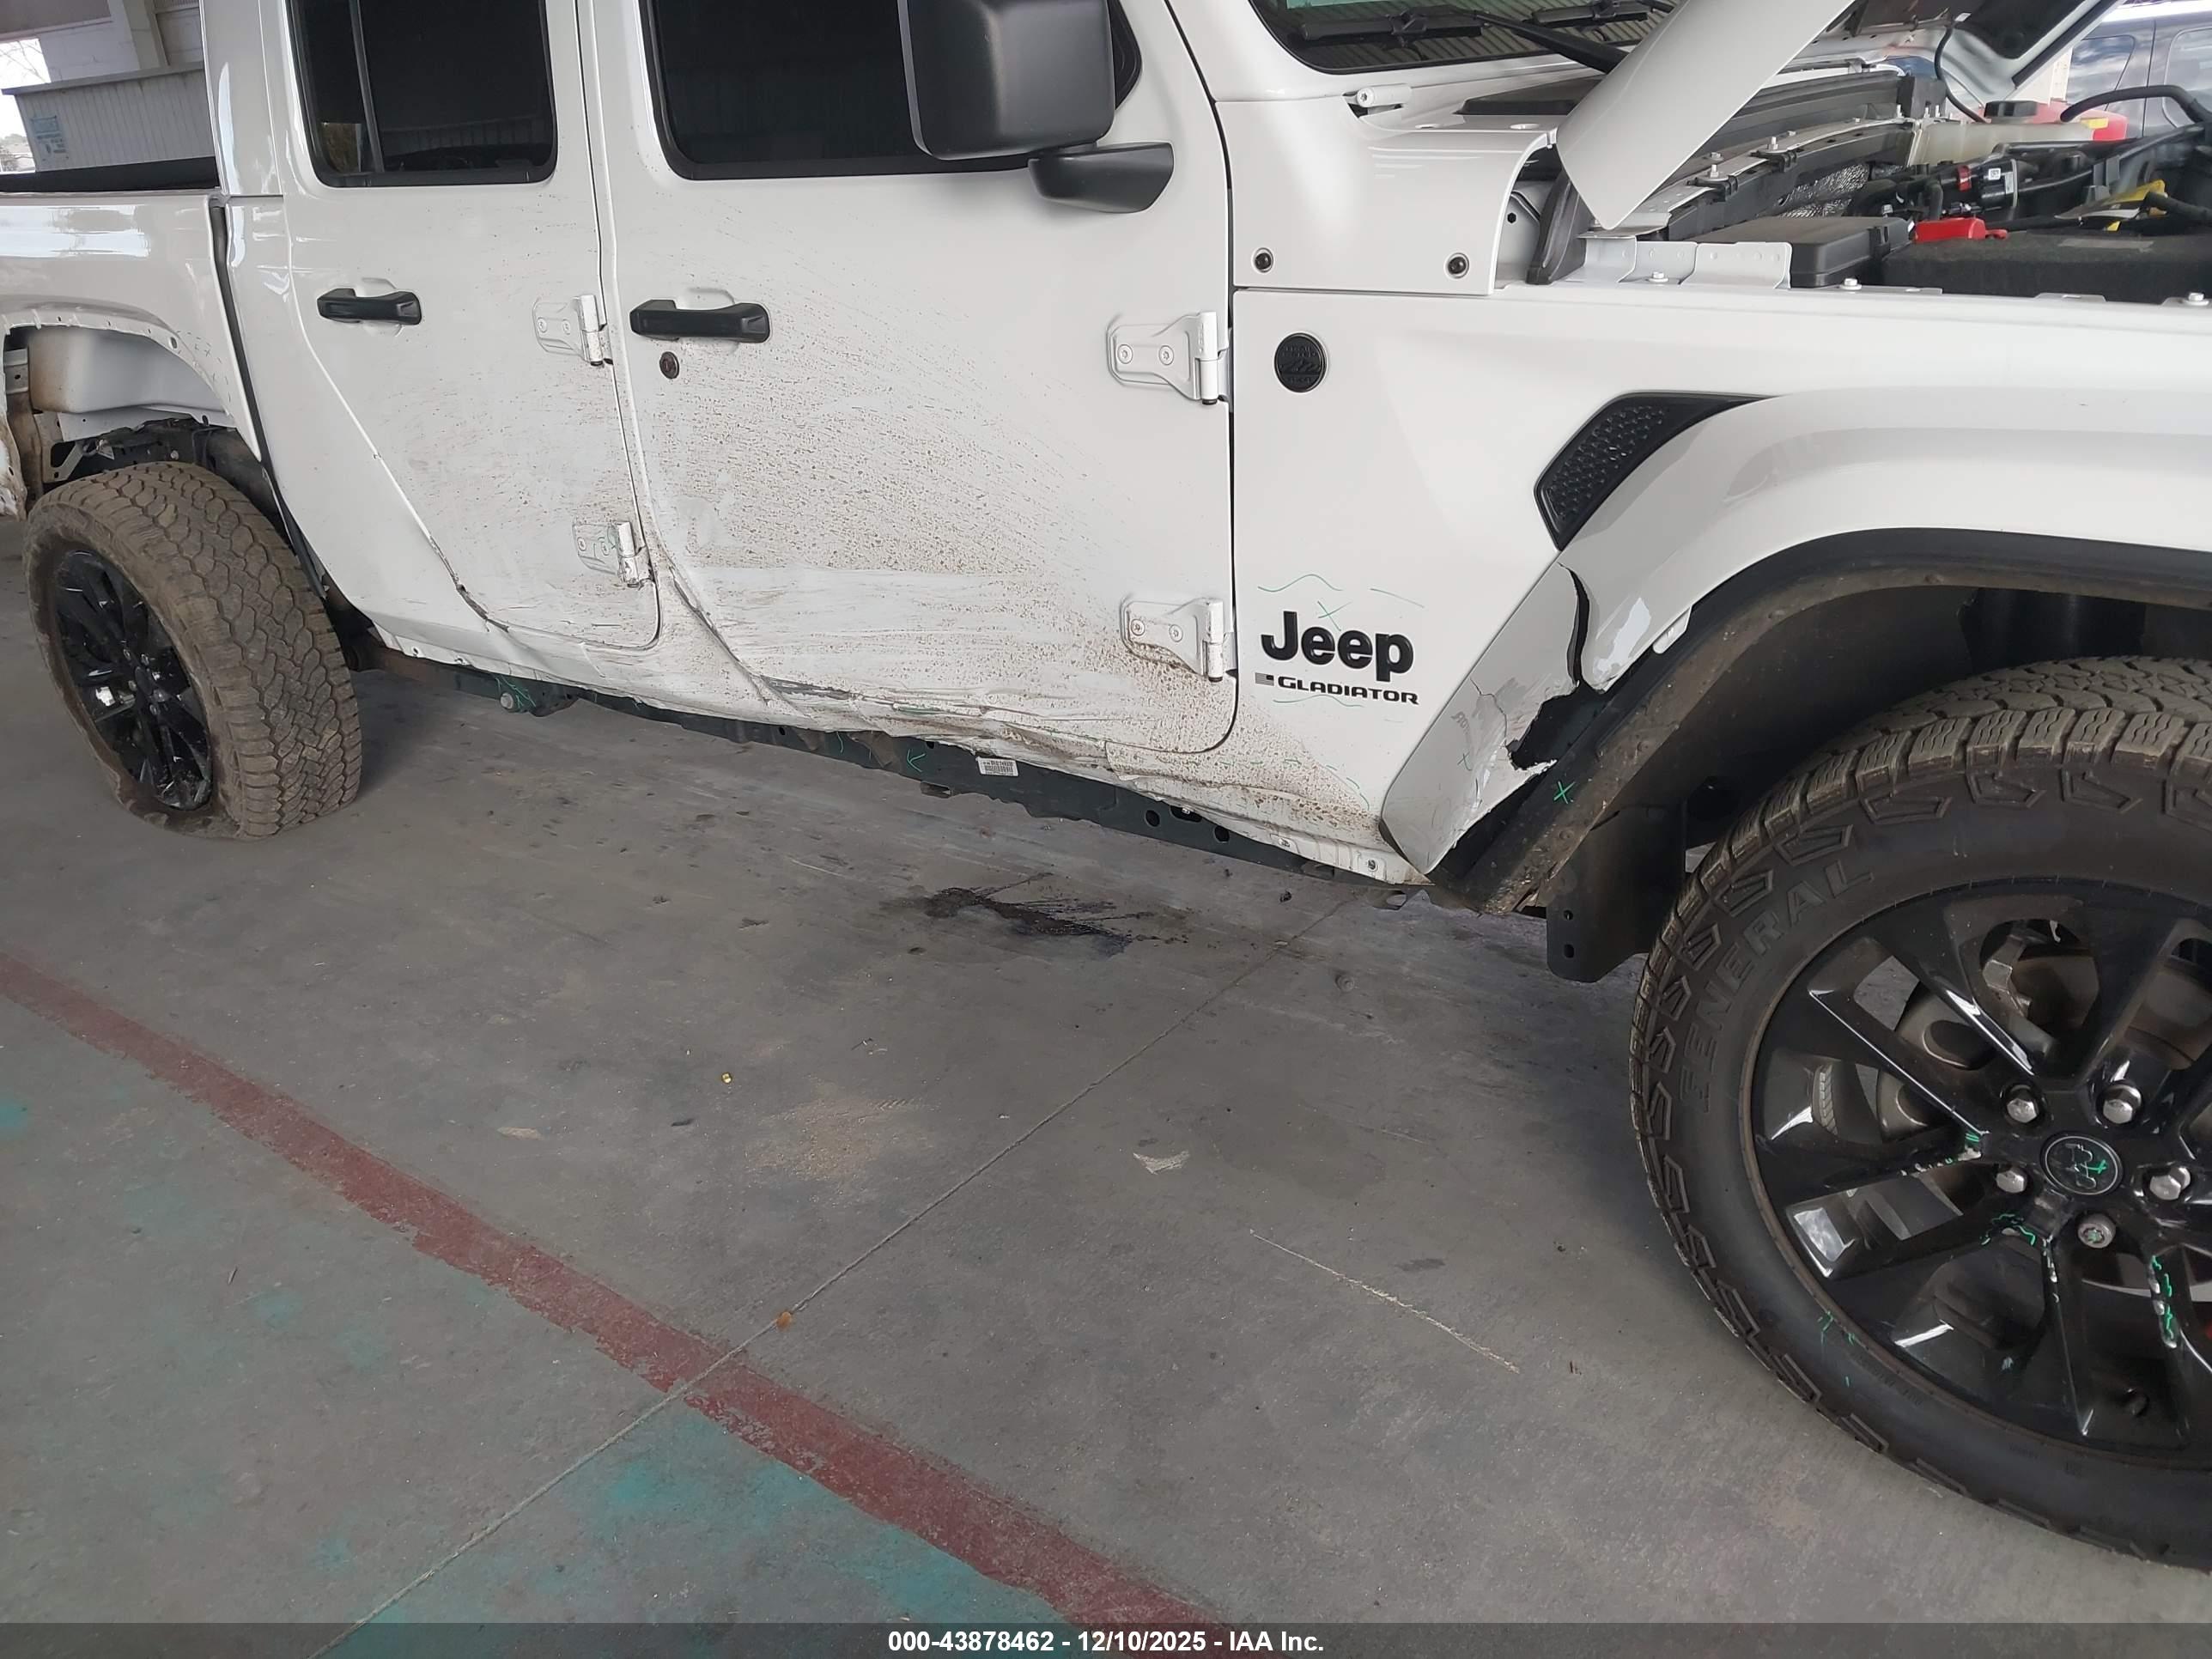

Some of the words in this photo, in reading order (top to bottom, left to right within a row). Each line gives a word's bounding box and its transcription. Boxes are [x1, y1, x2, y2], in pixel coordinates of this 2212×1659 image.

[1260, 610, 1415, 684] Jeep
[1277, 675, 1419, 706] GLADIATOR
[1679, 859, 1875, 1115] GENERAL
